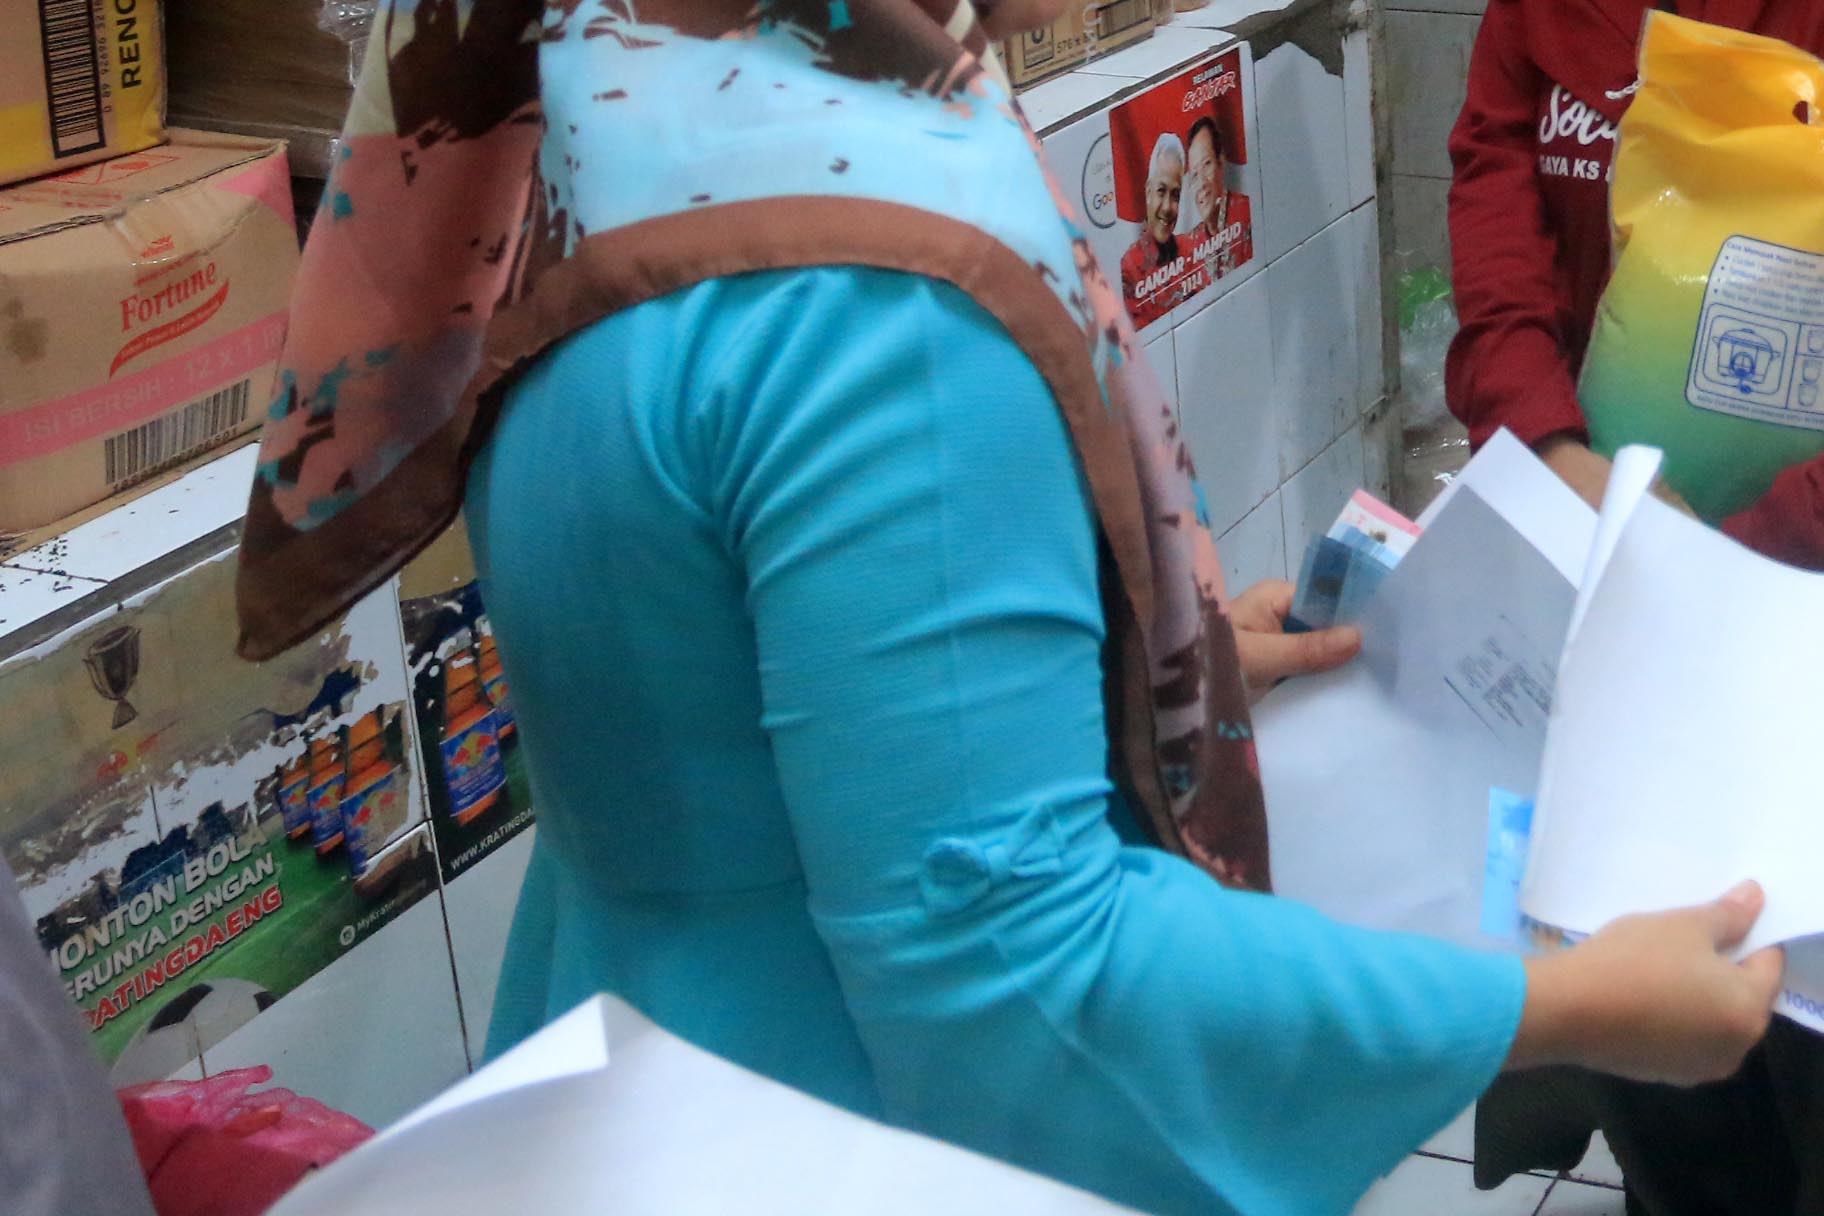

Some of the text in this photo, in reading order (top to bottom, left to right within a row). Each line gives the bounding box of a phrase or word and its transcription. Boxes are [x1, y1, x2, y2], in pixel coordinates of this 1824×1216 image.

[1092, 191, 1115, 210] Goo
[1573, 158, 1600, 180] KS
[1135, 254, 1186, 299] GANJAR
[1192, 221, 1242, 265] MAHFUD
[119, 261, 216, 333] Fortune
[70, 381, 162, 429] BERSIH
[185, 358, 214, 384] 12
[183, 819, 268, 893] BOLA
[70, 852, 274, 1001] RUNYA DENGAN
